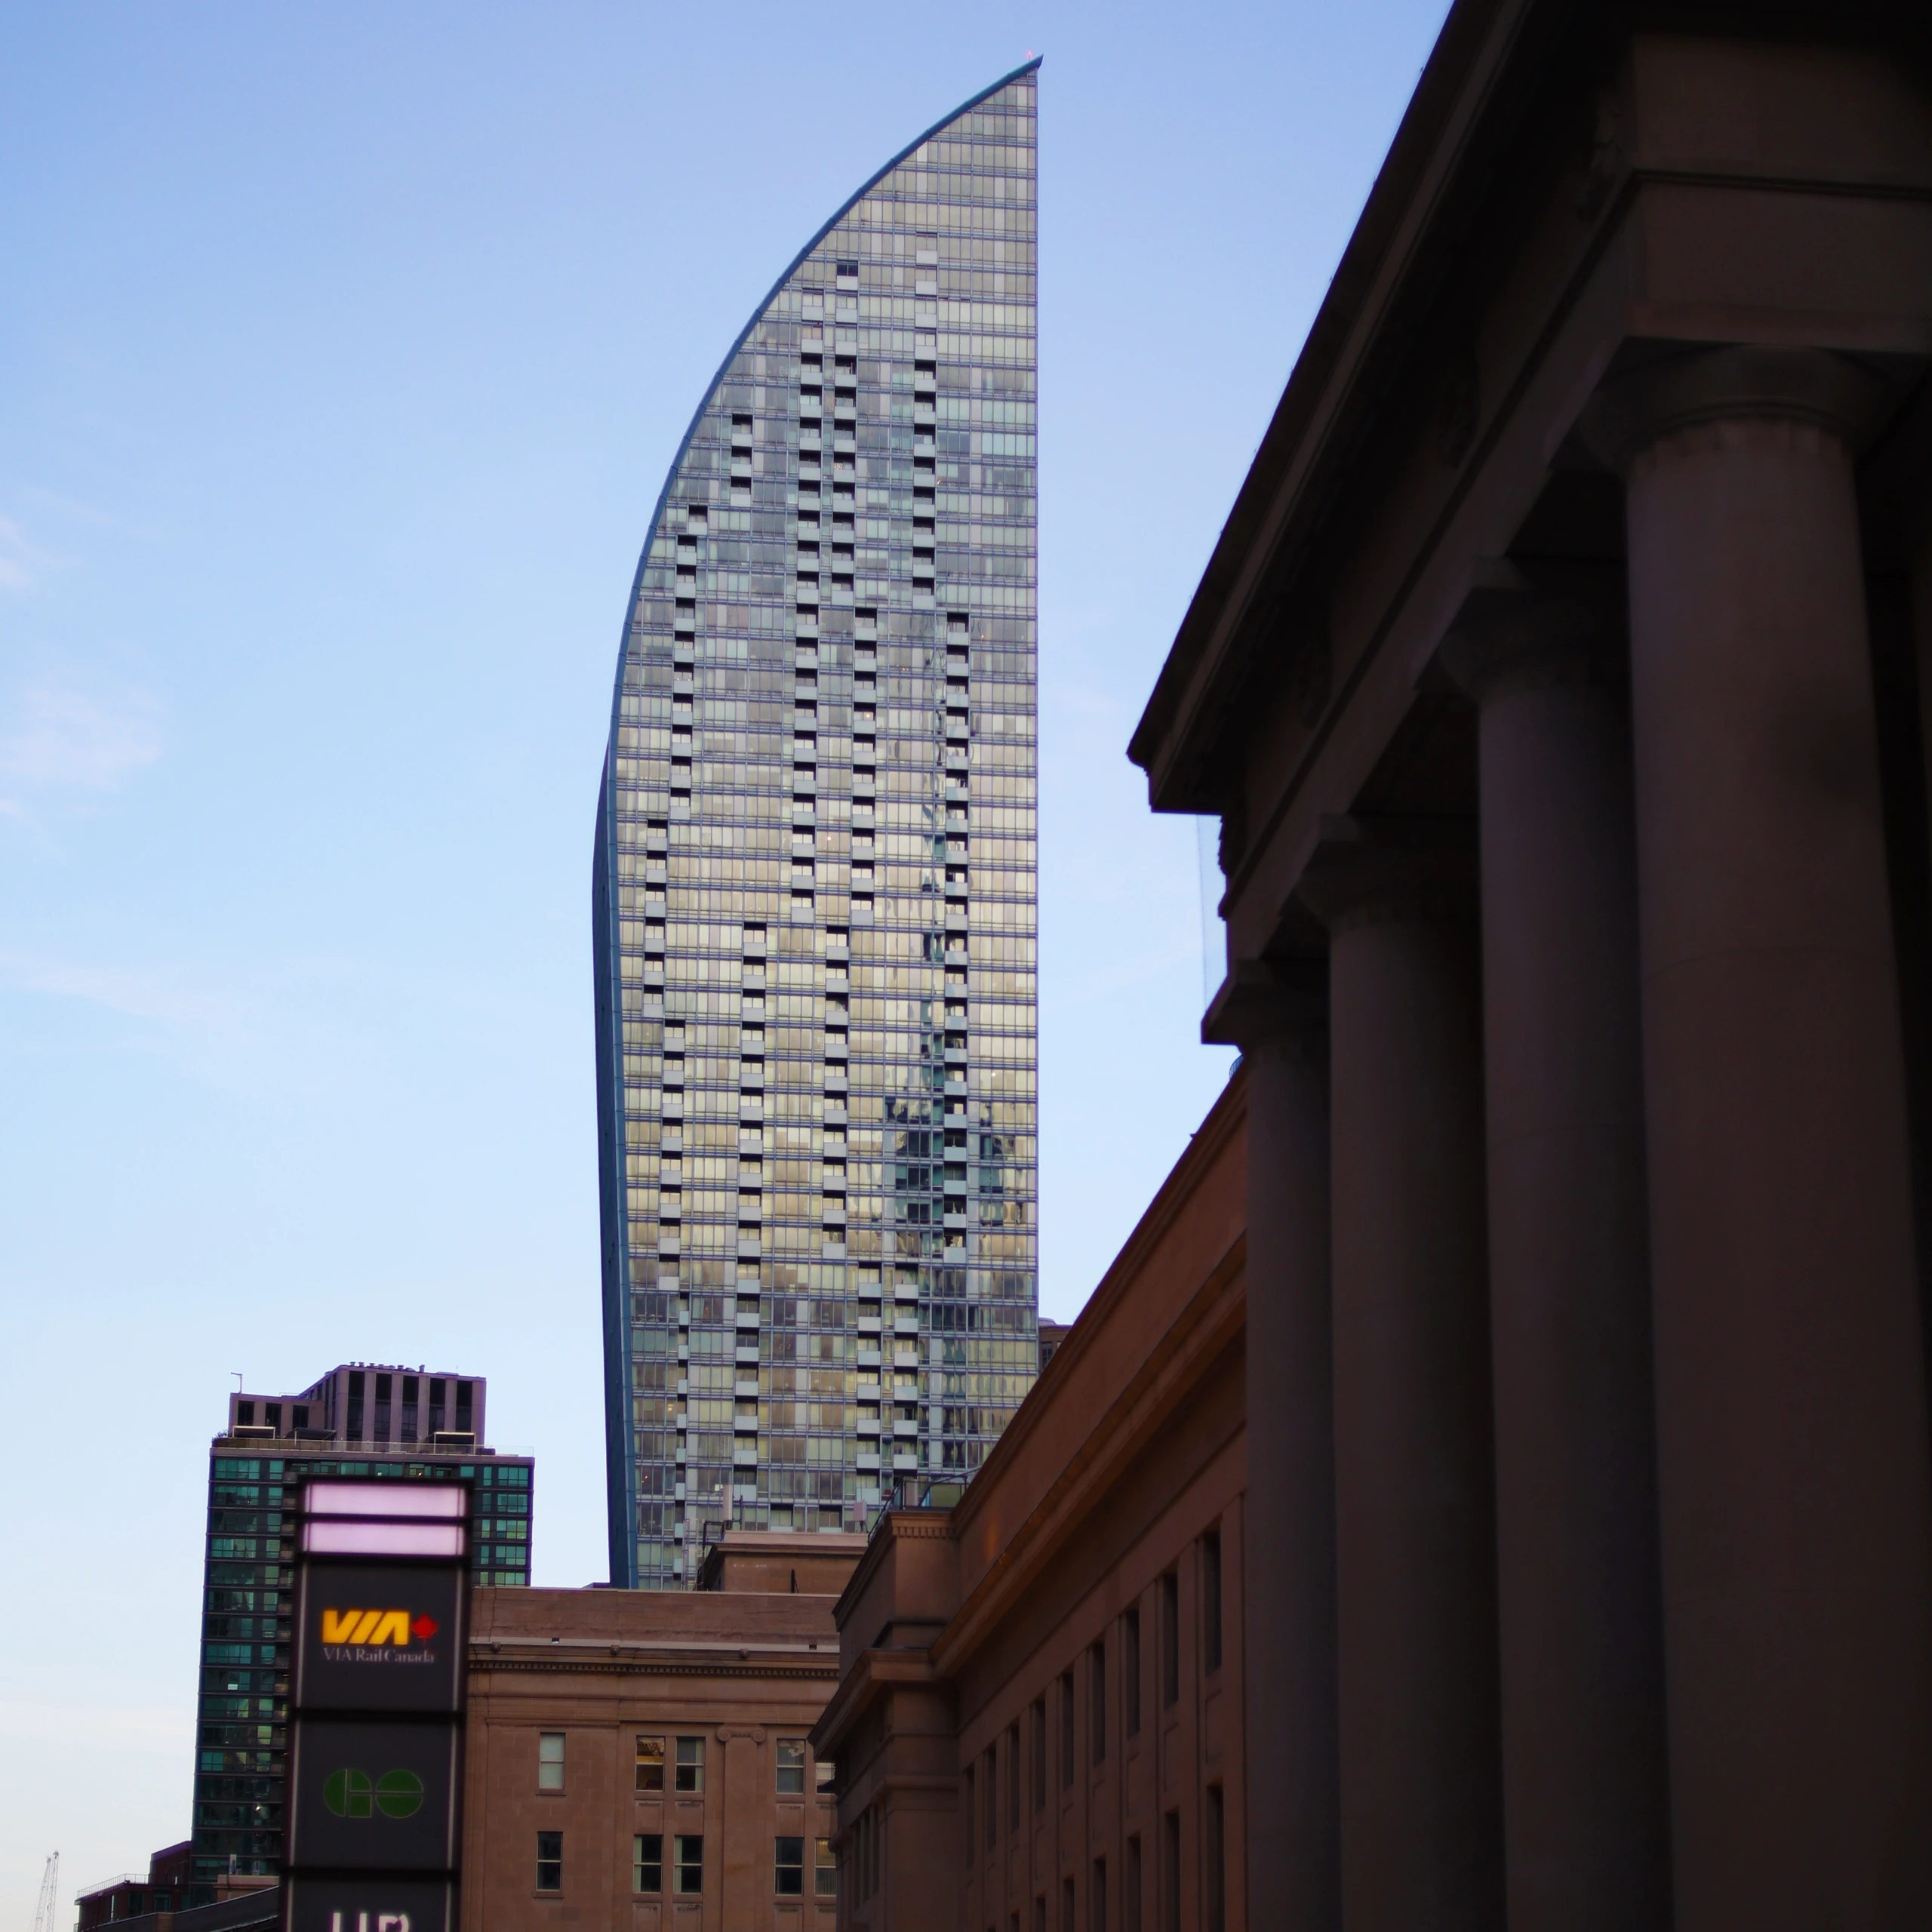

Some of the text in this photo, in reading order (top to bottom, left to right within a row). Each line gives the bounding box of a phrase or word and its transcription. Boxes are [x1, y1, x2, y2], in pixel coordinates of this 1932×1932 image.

[321, 1609, 410, 1645] VIA
[323, 1647, 435, 1663] VIA Rail Canada
[323, 1768, 424, 1819] GO
